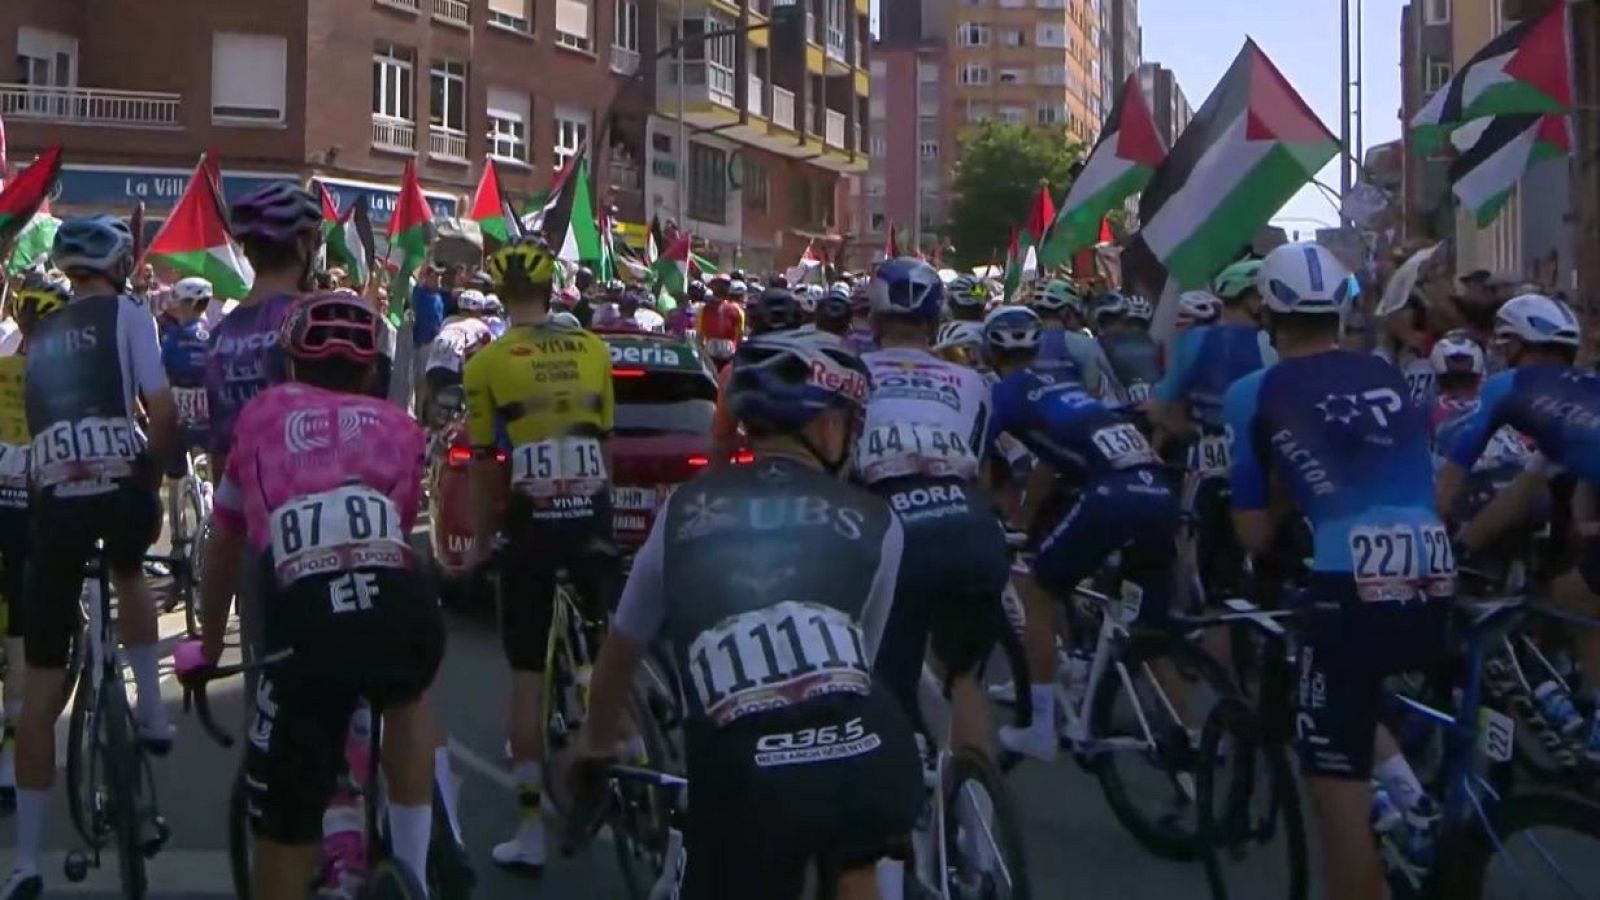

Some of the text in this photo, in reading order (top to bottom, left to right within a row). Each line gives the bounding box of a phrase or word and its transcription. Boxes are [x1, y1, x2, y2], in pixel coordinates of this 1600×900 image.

[125, 177, 148, 197] La
[370, 193, 384, 210] La
[869, 425, 966, 457] 44 44
[523, 444, 600, 478] 15 15
[1271, 430, 1334, 495] FACTOR
[892, 485, 967, 510] BORA
[281, 495, 388, 554] 87 87
[749, 496, 864, 540] UBS
[1353, 534, 1412, 577] 227
[329, 573, 380, 613] EF
[756, 717, 864, 751] Q36.5
